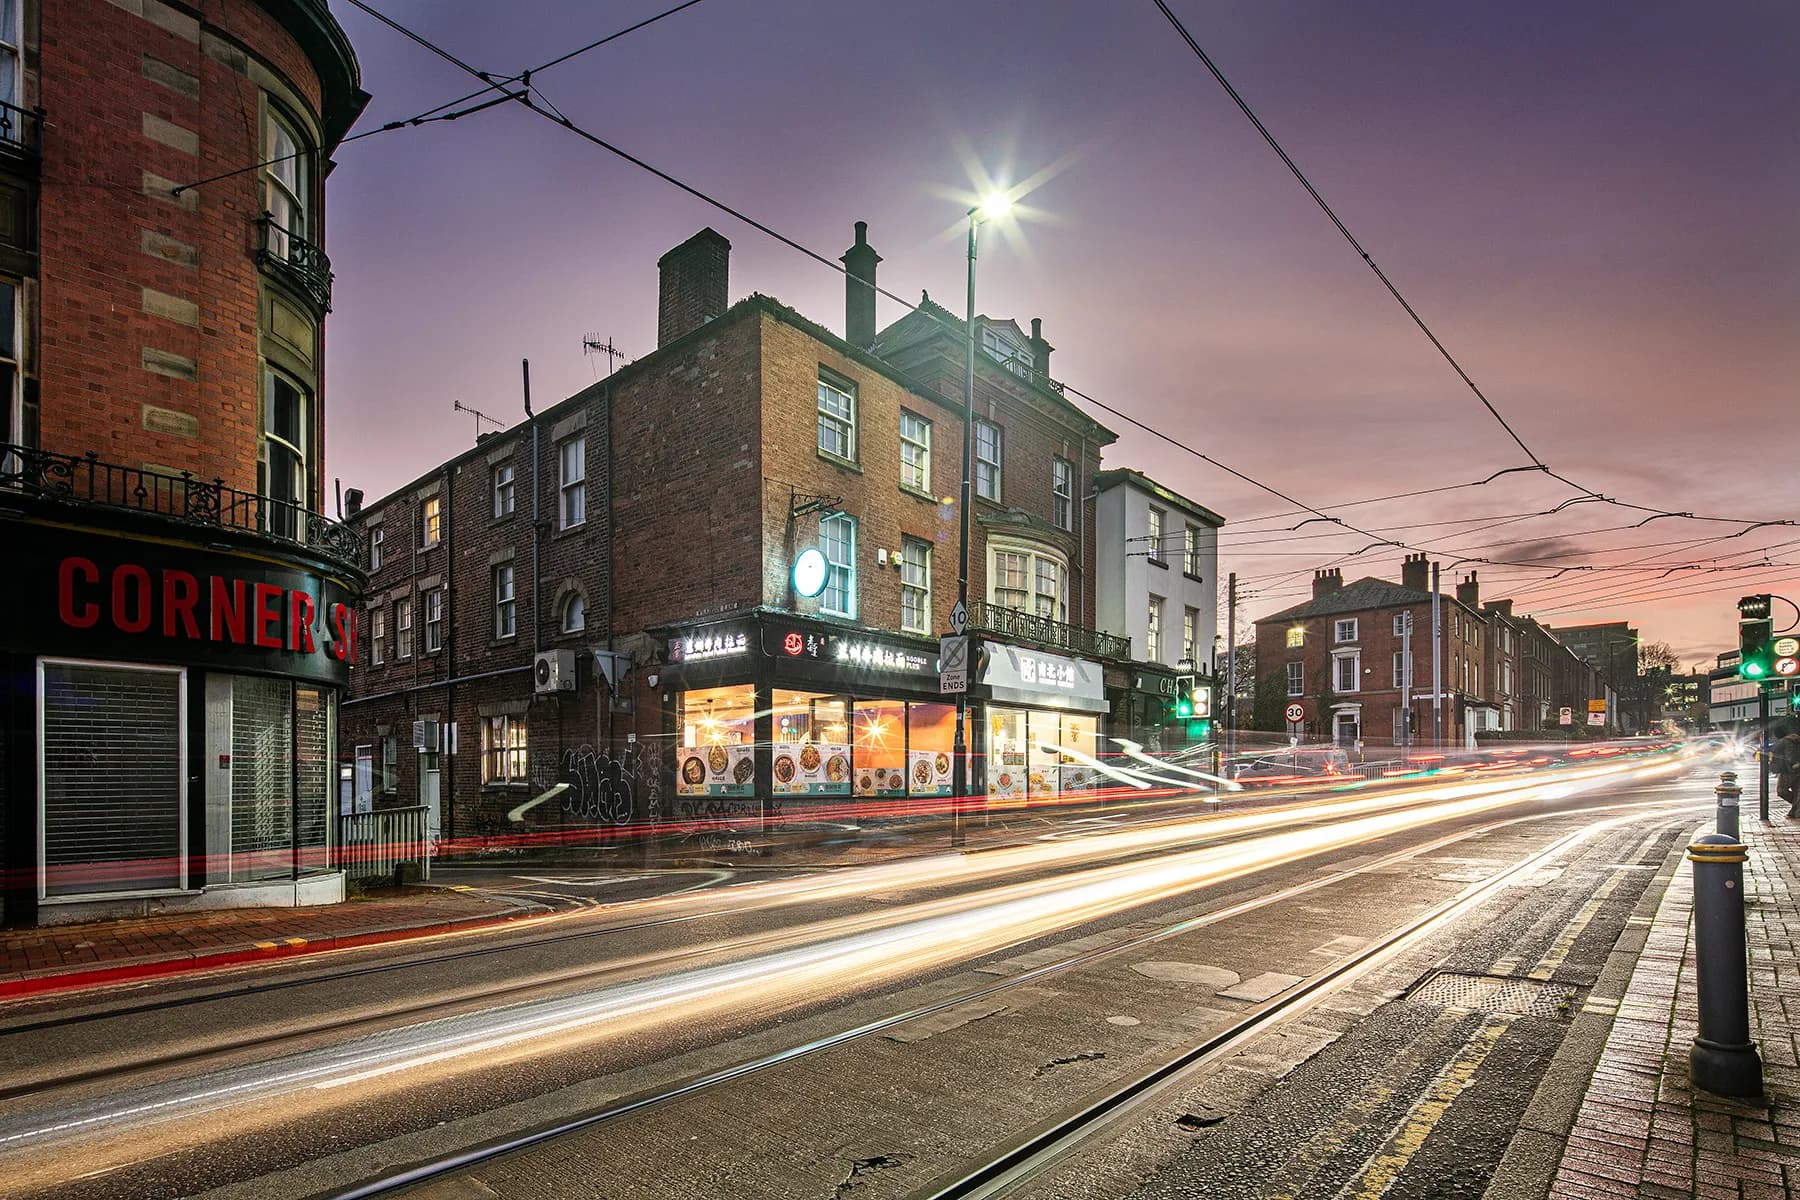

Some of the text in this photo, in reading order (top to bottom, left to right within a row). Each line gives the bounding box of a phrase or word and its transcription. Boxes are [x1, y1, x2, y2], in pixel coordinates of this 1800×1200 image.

[59, 557, 316, 654] CORNER
[952, 611, 966, 626] 10
[942, 681, 965, 691] ENDS
[1288, 708, 1303, 717] 30
